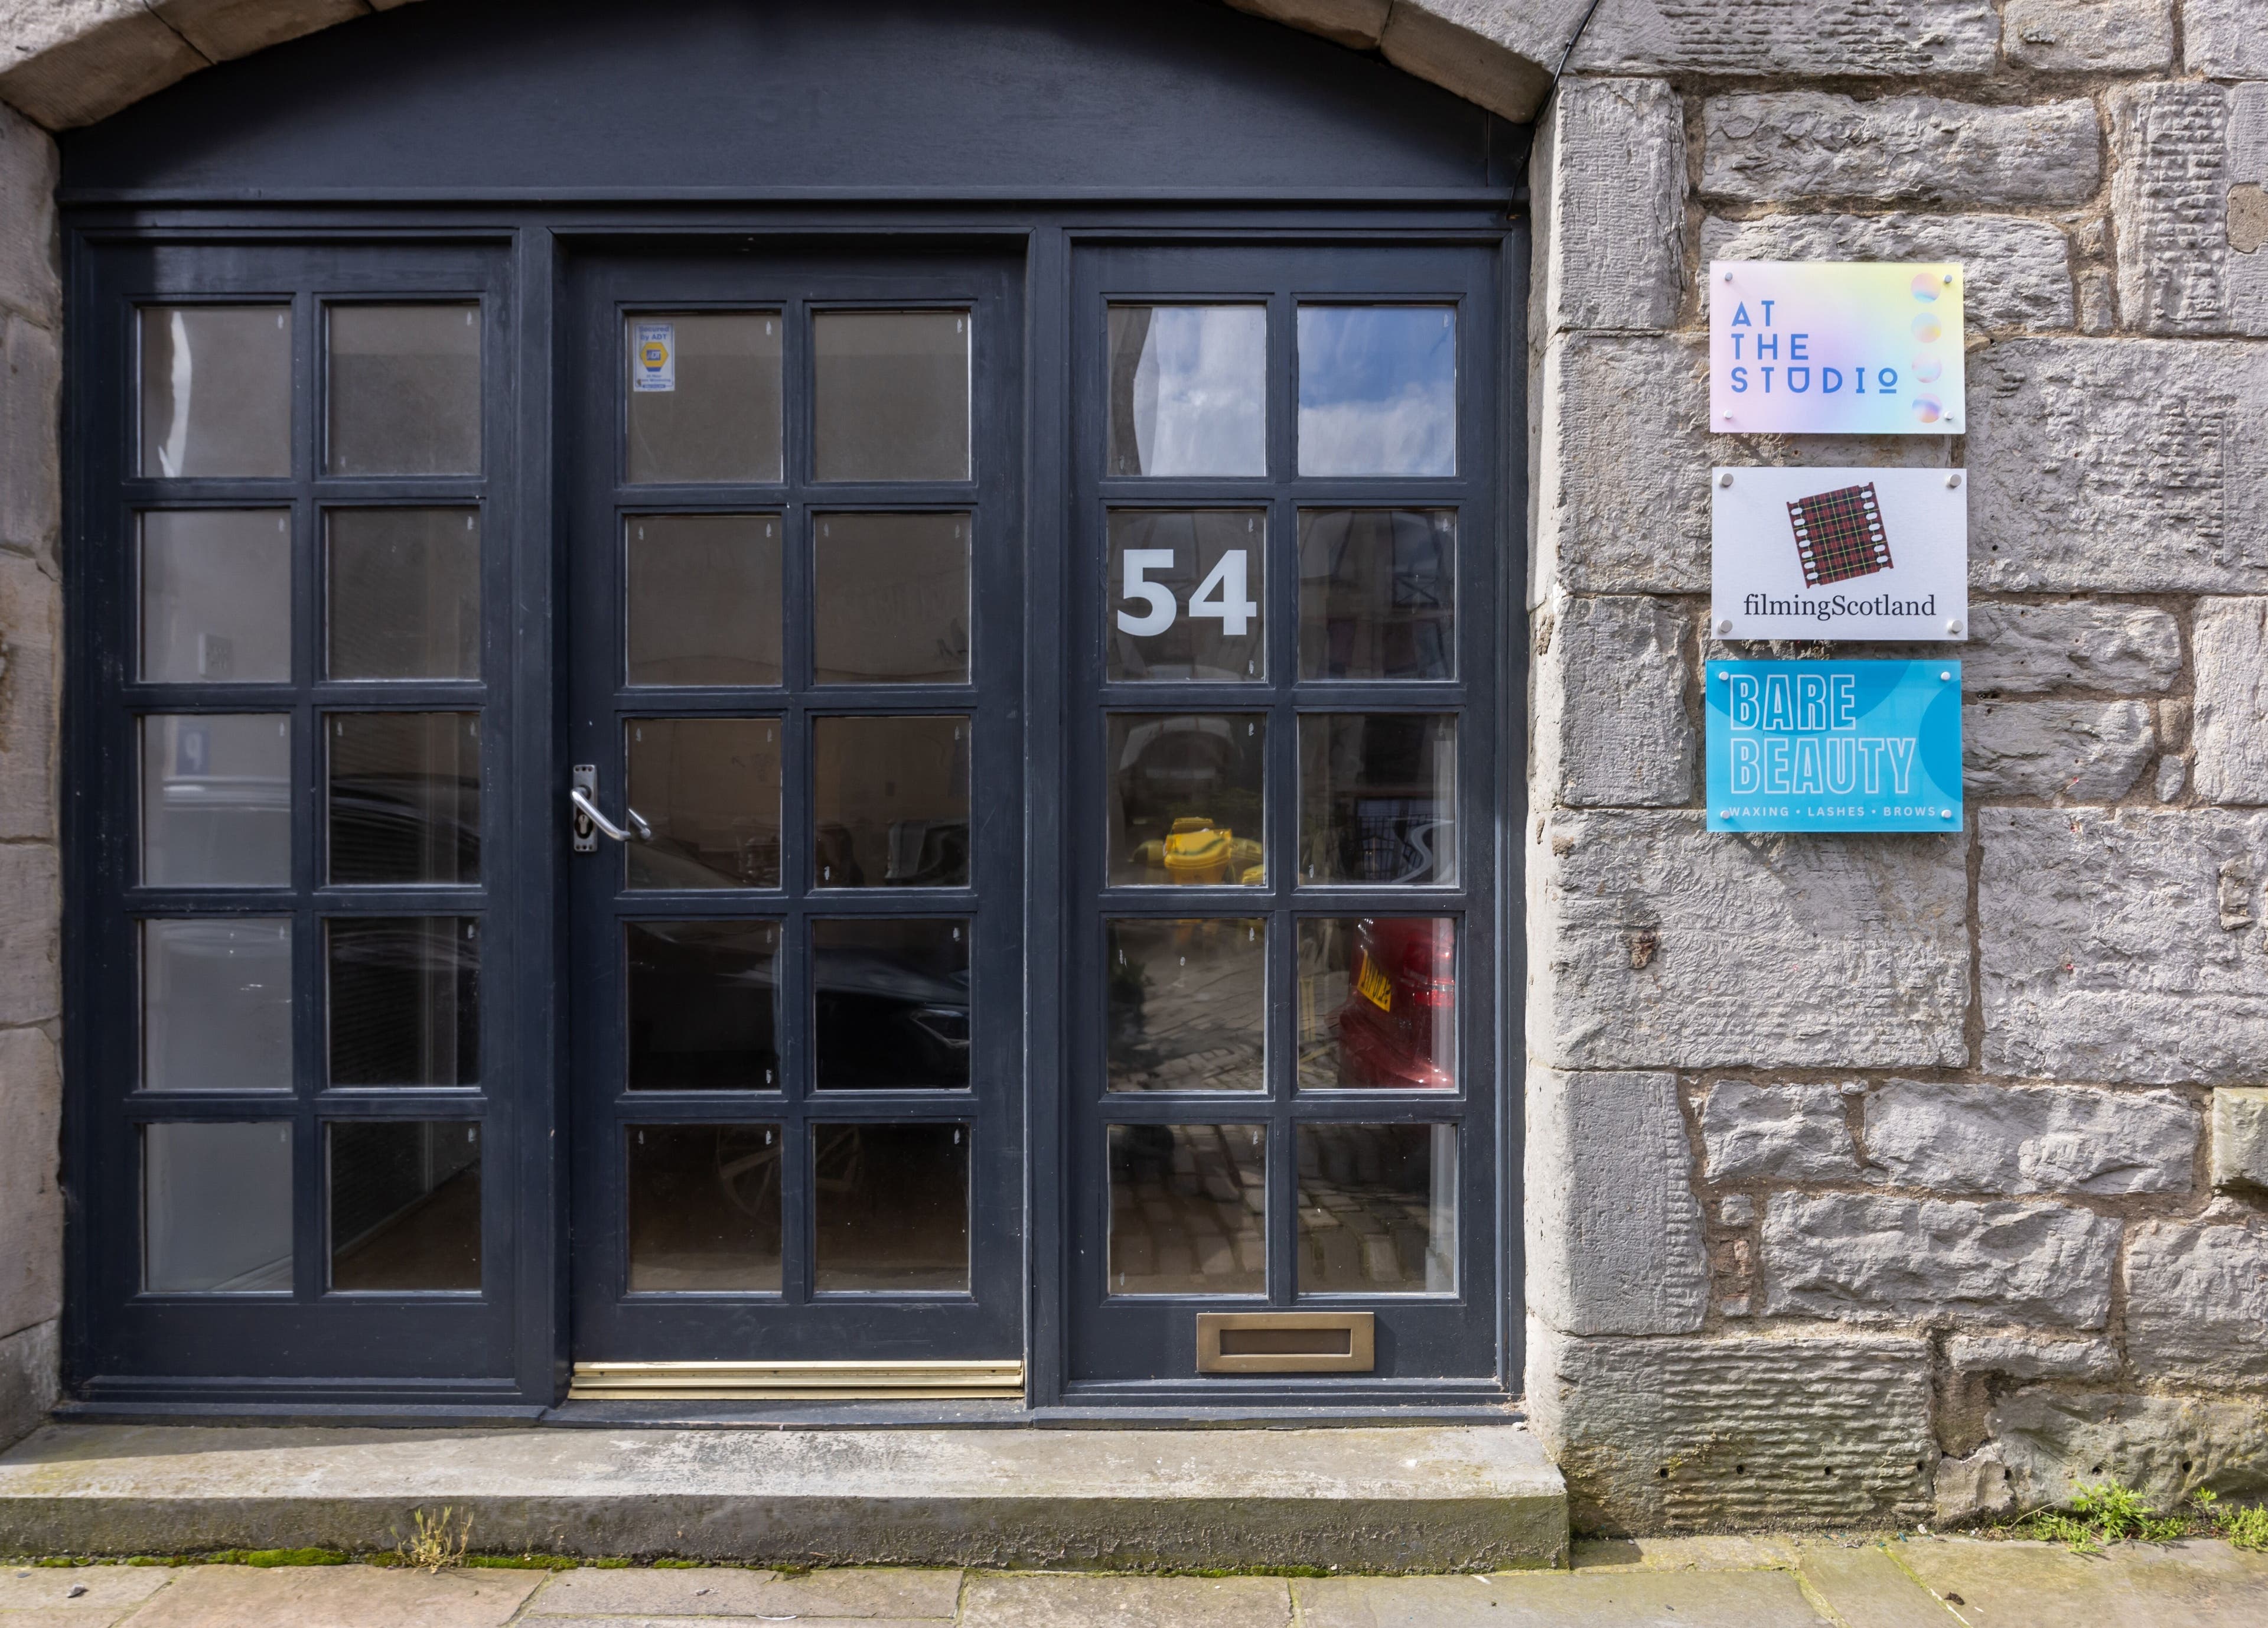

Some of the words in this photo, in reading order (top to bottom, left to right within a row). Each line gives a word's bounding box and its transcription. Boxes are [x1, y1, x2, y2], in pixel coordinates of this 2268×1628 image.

[1731, 300, 1775, 327] AT
[1731, 333, 1808, 360] THE
[1731, 367, 1898, 393] STUDIO
[1117, 549, 1257, 637] 54
[1744, 594, 1937, 621] filmingScotland
[1729, 674, 1856, 731] BARE
[1731, 737, 1916, 794] BEAUTY
[1729, 806, 1789, 816] WAXING
[1808, 806, 1865, 816] LASHES
[1884, 806, 1936, 816] BROWS
